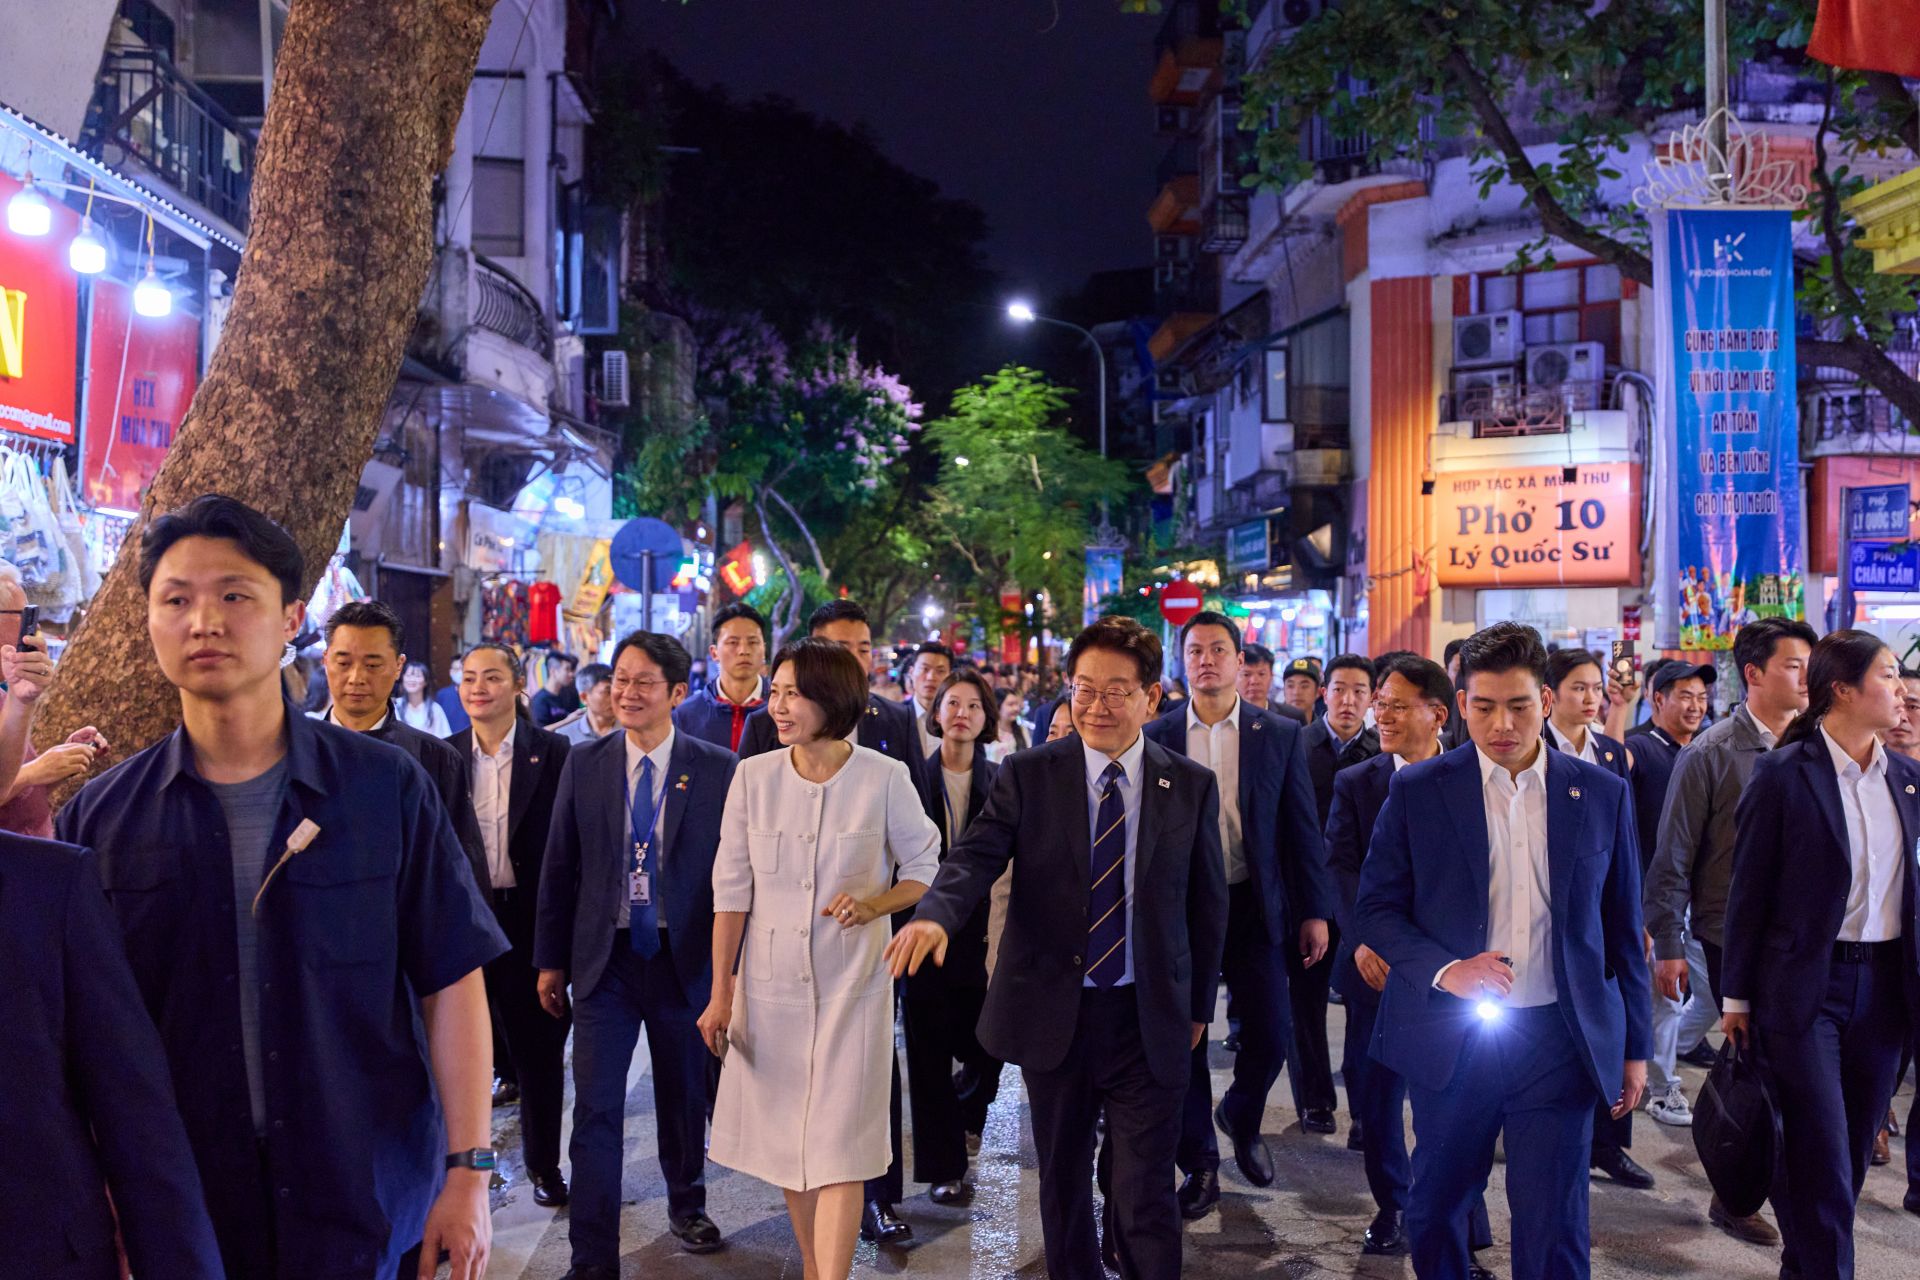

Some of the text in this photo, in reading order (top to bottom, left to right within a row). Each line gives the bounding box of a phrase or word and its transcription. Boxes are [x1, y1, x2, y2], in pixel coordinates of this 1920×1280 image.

[1728, 366, 1750, 391] LÀM
[1713, 412, 1728, 433] AN
[1582, 472, 1609, 484] THU
[1695, 494, 1717, 514] CHO
[1457, 499, 1605, 535] Phở 10
[1449, 538, 1614, 569] Lý Quốc Sư
